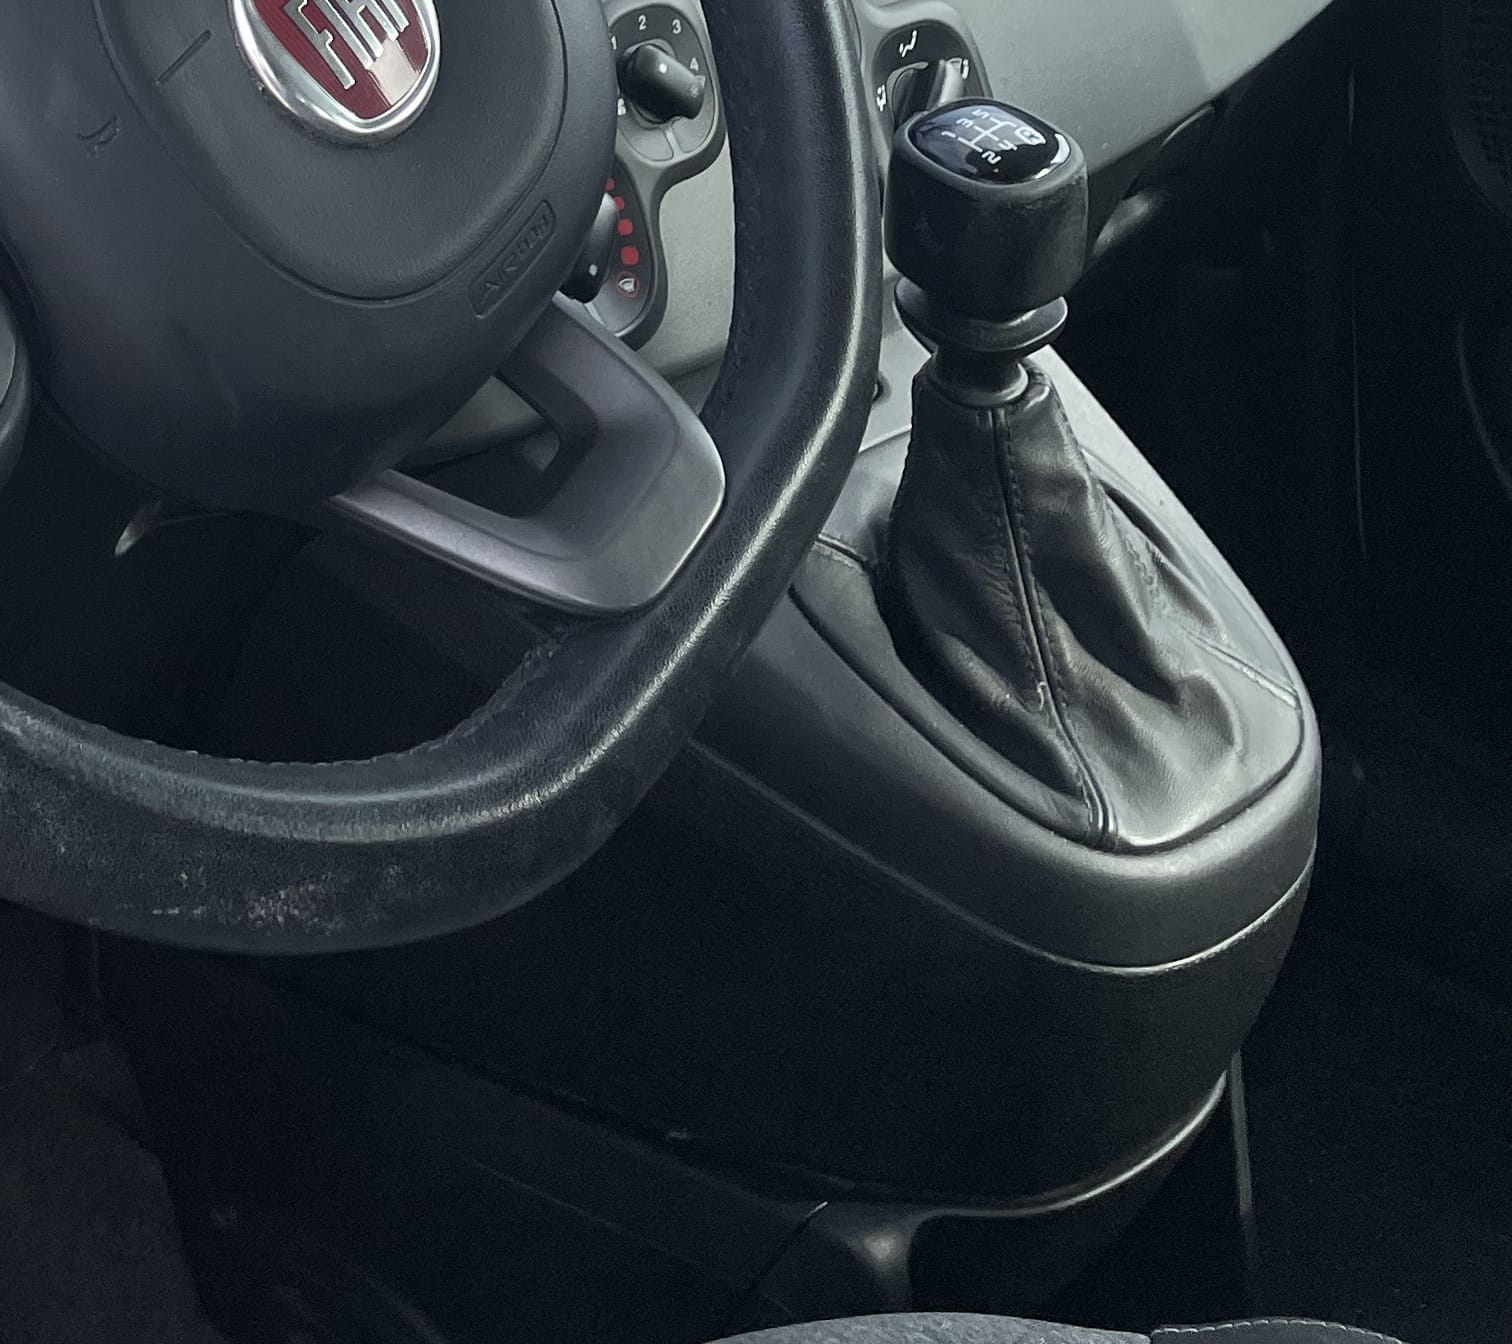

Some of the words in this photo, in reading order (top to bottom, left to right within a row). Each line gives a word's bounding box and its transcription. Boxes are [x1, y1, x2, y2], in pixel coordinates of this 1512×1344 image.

[637, 15, 647, 31] 2
[672, 19, 682, 34] 3
[610, 34, 617, 50] 1
[689, 56, 699, 71] 4
[956, 117, 974, 128] 3
[981, 150, 1002, 165] 2
